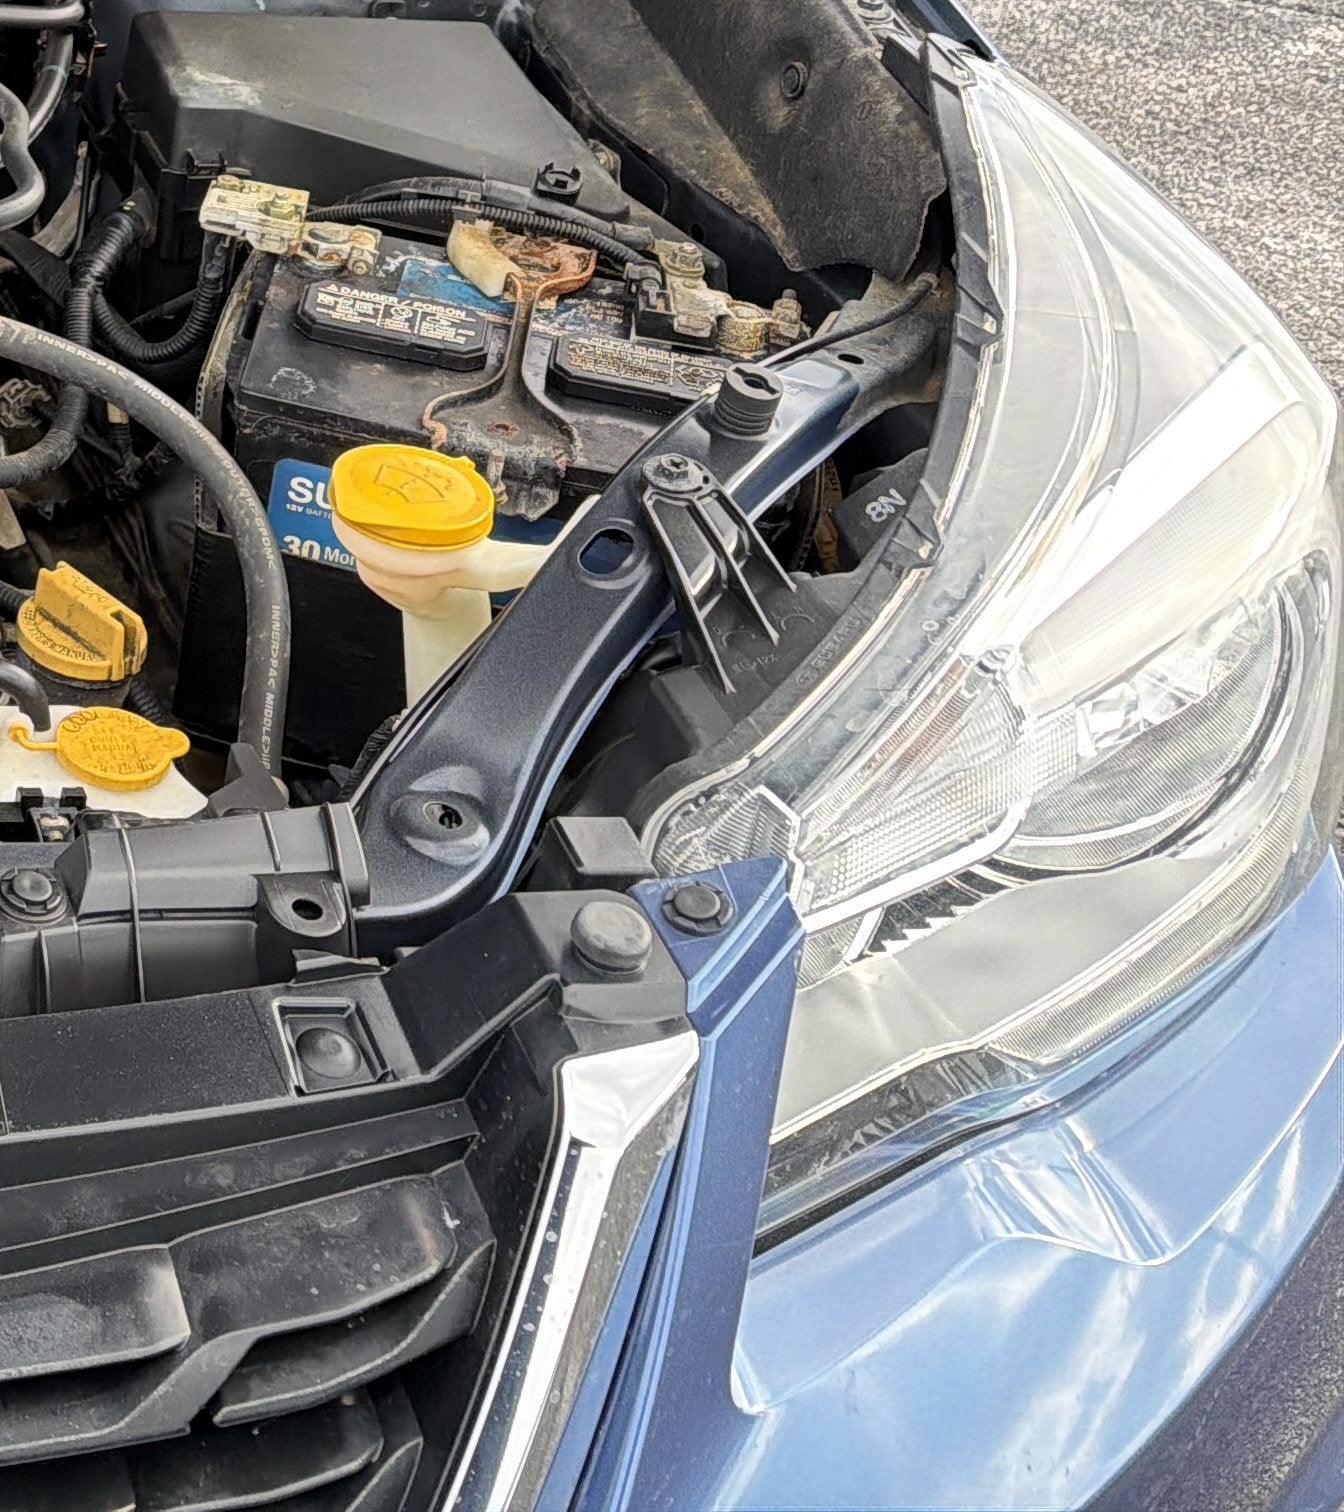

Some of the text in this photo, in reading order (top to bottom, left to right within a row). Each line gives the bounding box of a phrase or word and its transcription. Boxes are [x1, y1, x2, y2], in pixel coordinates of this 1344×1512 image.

[339, 285, 399, 306] DANGER
[413, 300, 467, 318] POISON
[285, 503, 304, 513] 12V
[282, 535, 321, 562] 30
